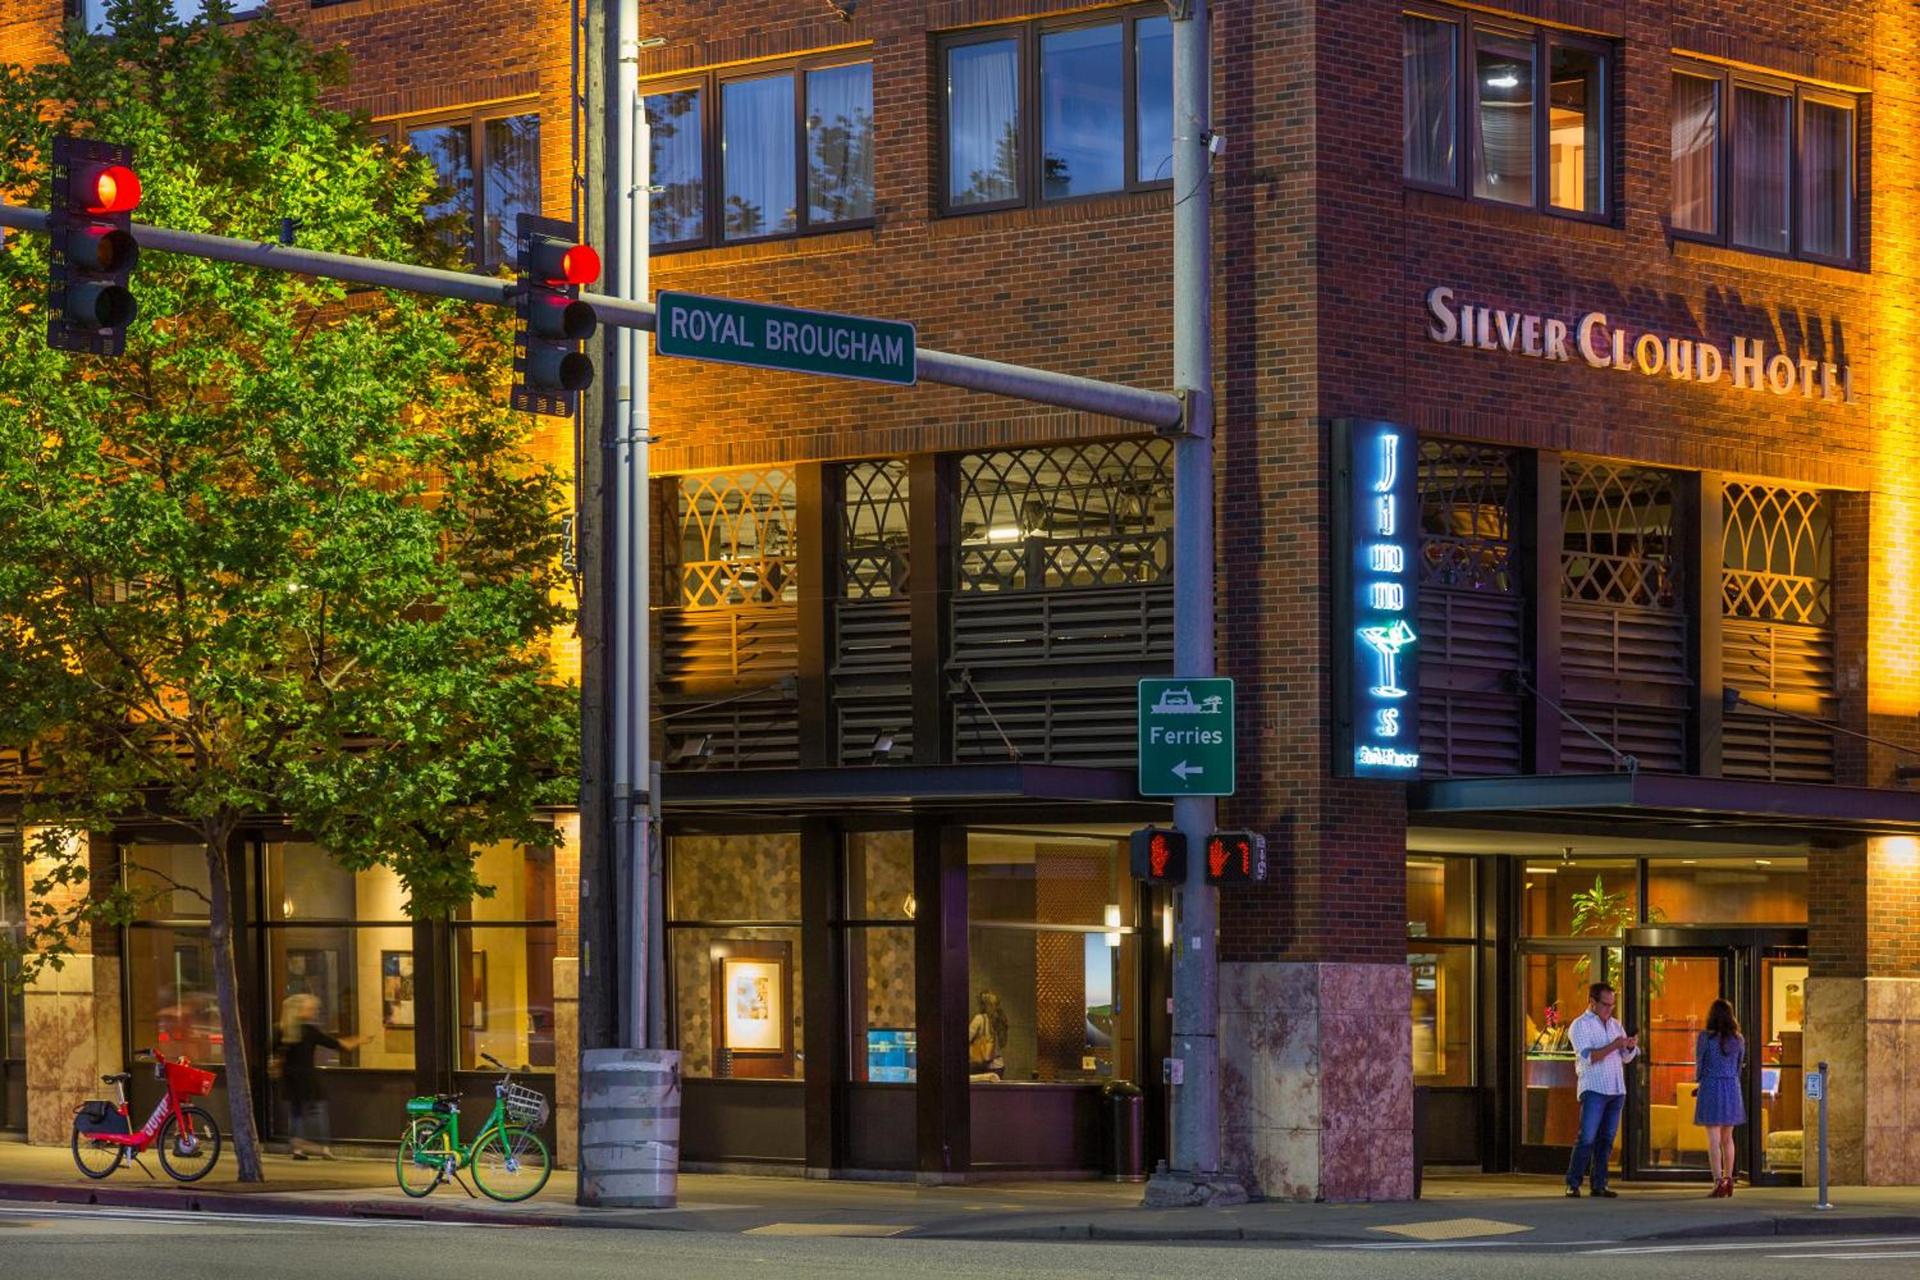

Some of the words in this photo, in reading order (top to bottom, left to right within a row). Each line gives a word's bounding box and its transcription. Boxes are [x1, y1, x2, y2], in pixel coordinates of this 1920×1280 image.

[671, 306, 754, 348] ROYAL
[765, 319, 903, 367] BROUGHAM
[1427, 286, 1568, 362] SILVER
[1577, 311, 1723, 384] CLOUD
[563, 519, 574, 567] 772
[1150, 726, 1223, 744] Ferries
[145, 1095, 170, 1137] JUMP
